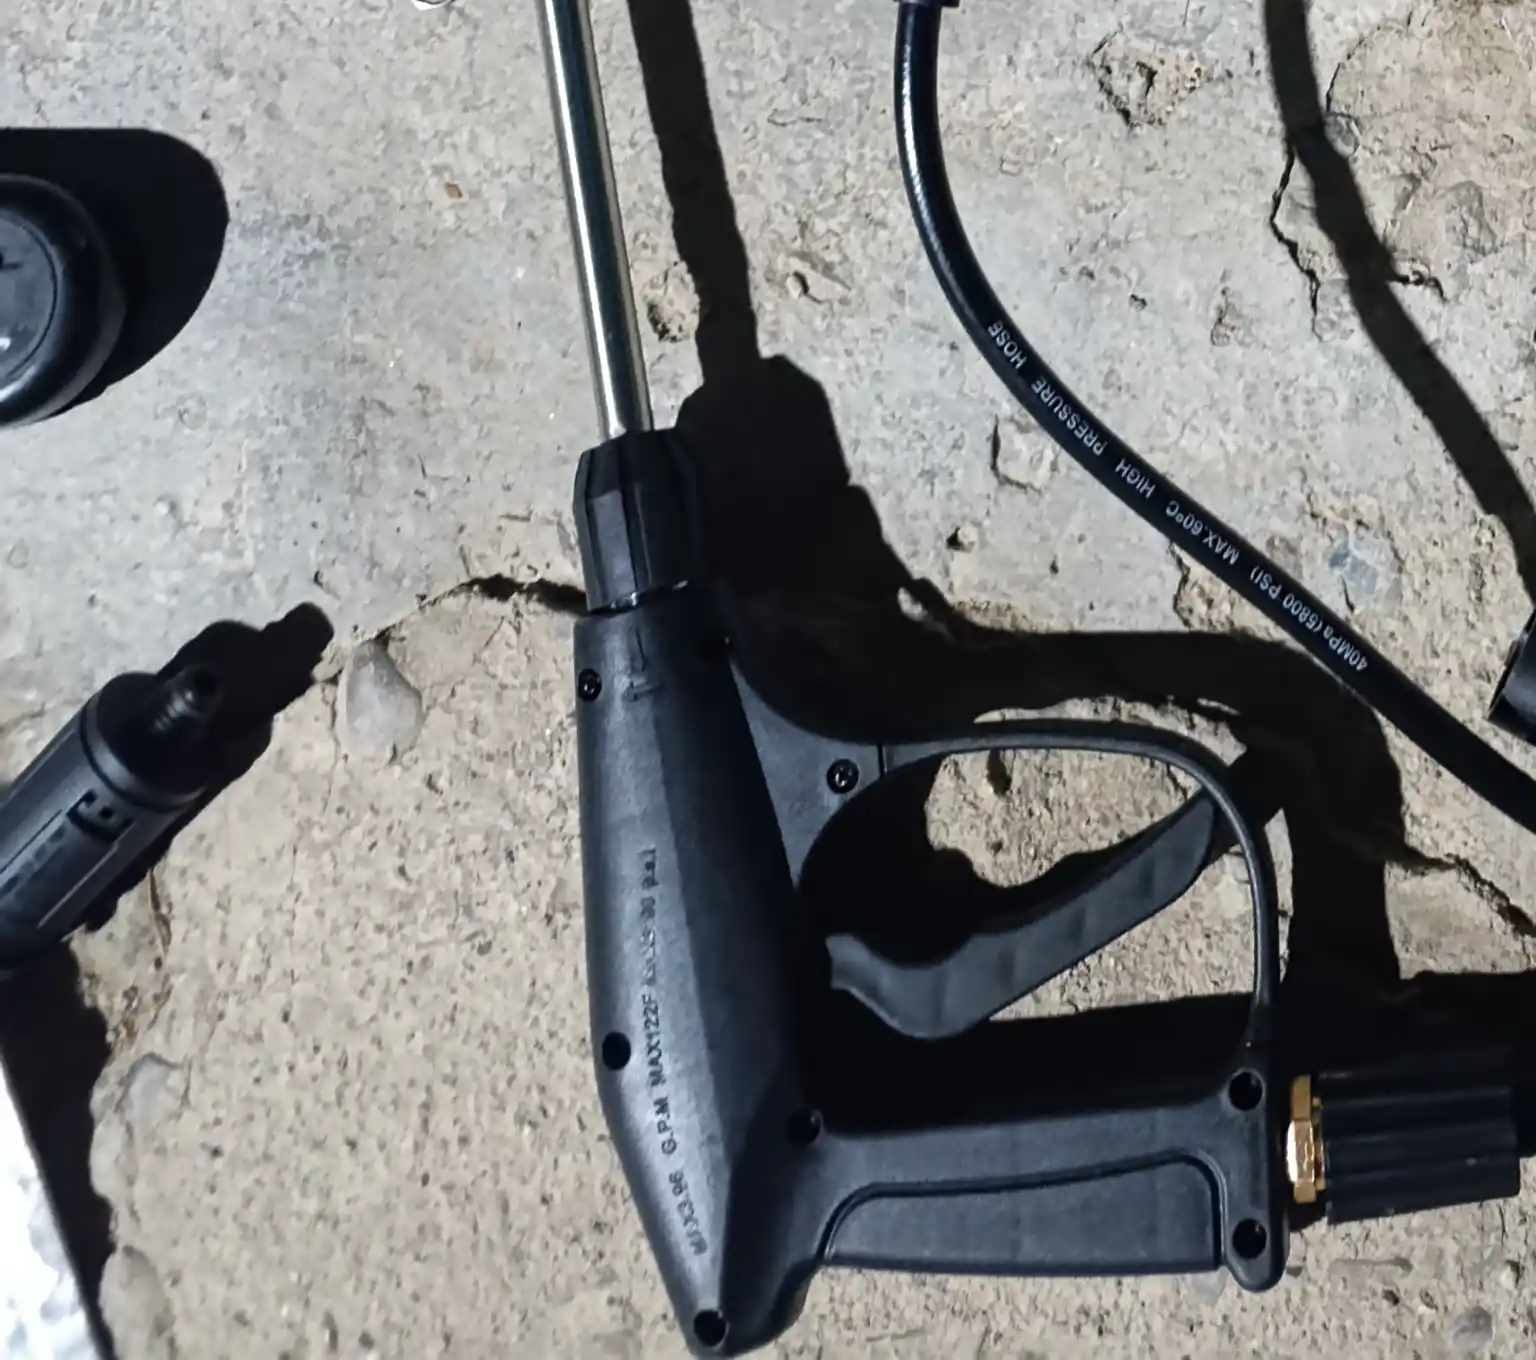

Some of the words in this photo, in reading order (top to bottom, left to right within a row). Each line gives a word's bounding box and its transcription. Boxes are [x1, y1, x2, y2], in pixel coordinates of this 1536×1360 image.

[987, 320, 1028, 370] HOSE
[1030, 375, 1109, 457] PRESSURE
[1114, 457, 1157, 499] HIGH
[1249, 564, 1283, 601] PSI)
